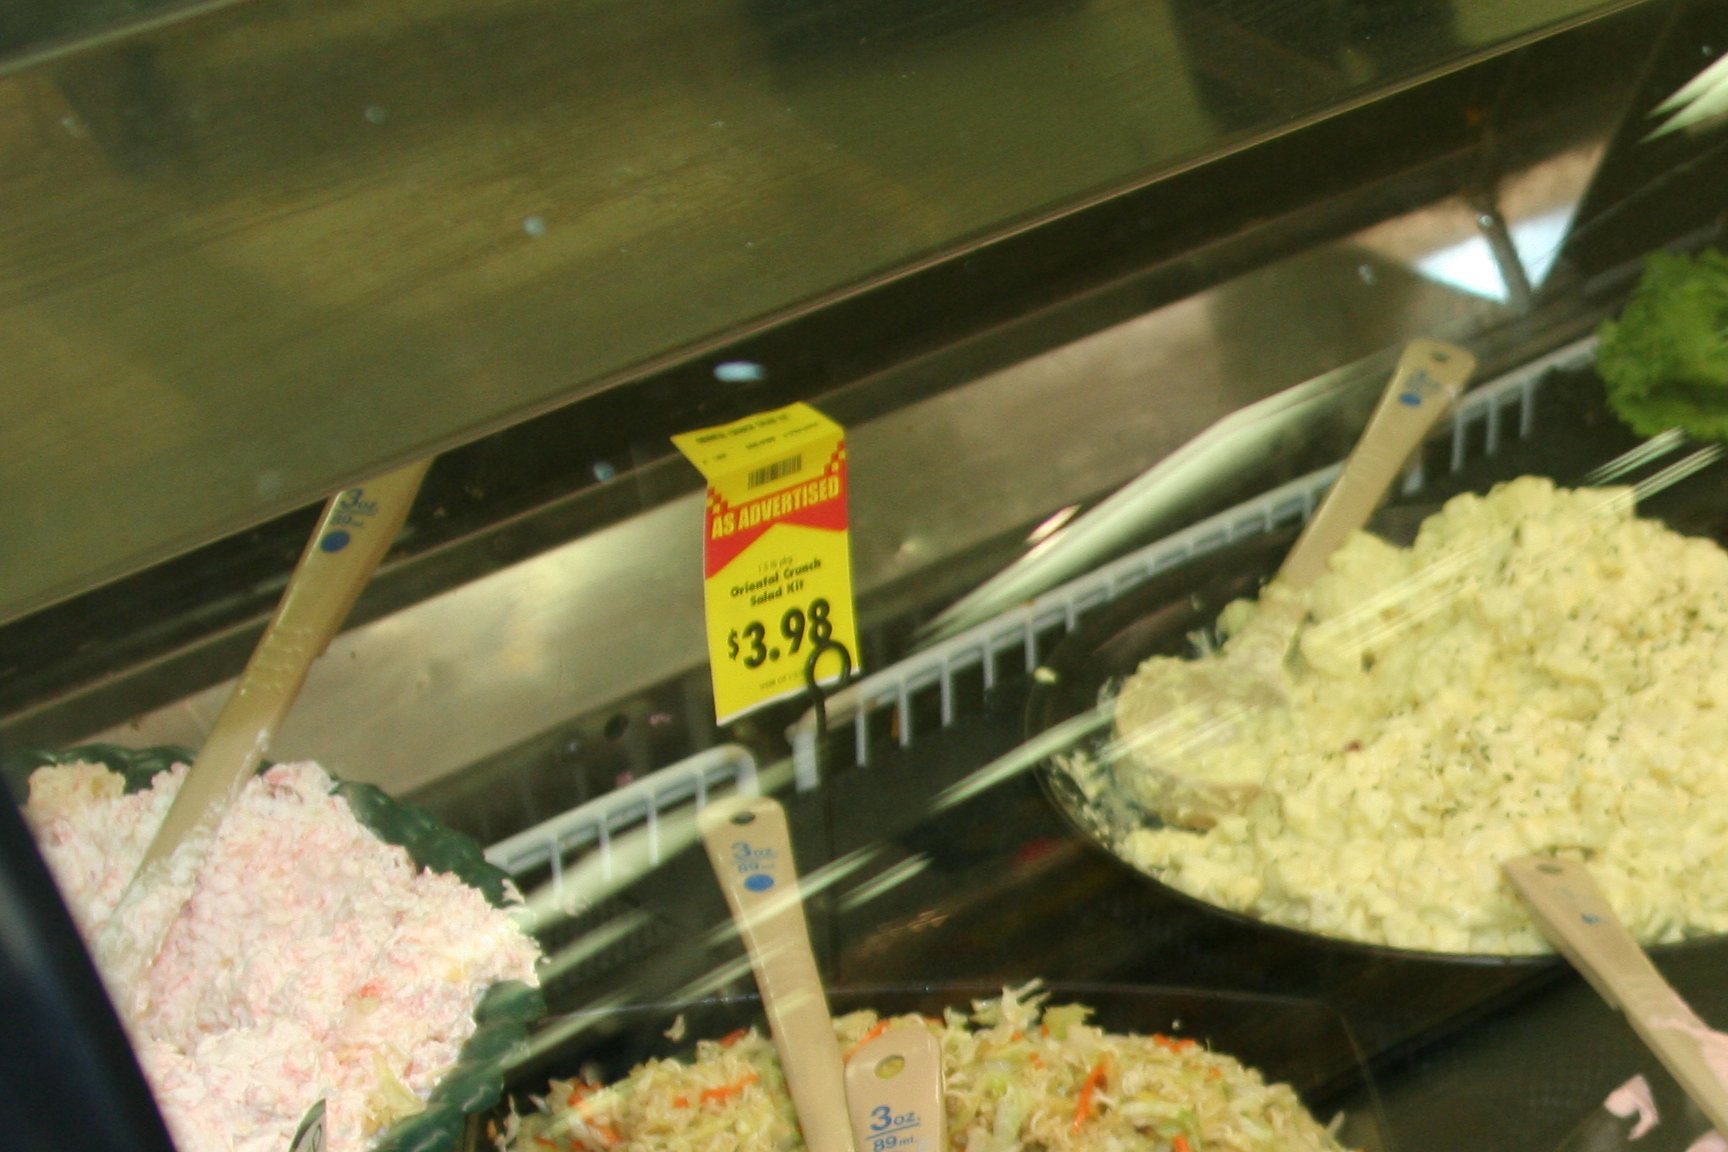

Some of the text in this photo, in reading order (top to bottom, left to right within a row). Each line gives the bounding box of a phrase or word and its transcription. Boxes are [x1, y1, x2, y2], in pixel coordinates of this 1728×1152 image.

[711, 476, 840, 540] AS ADVERTISED
[730, 558, 822, 597] Oriental Crunch
[750, 579, 804, 607] Salad Kit
[727, 597, 833, 670] $3.98
